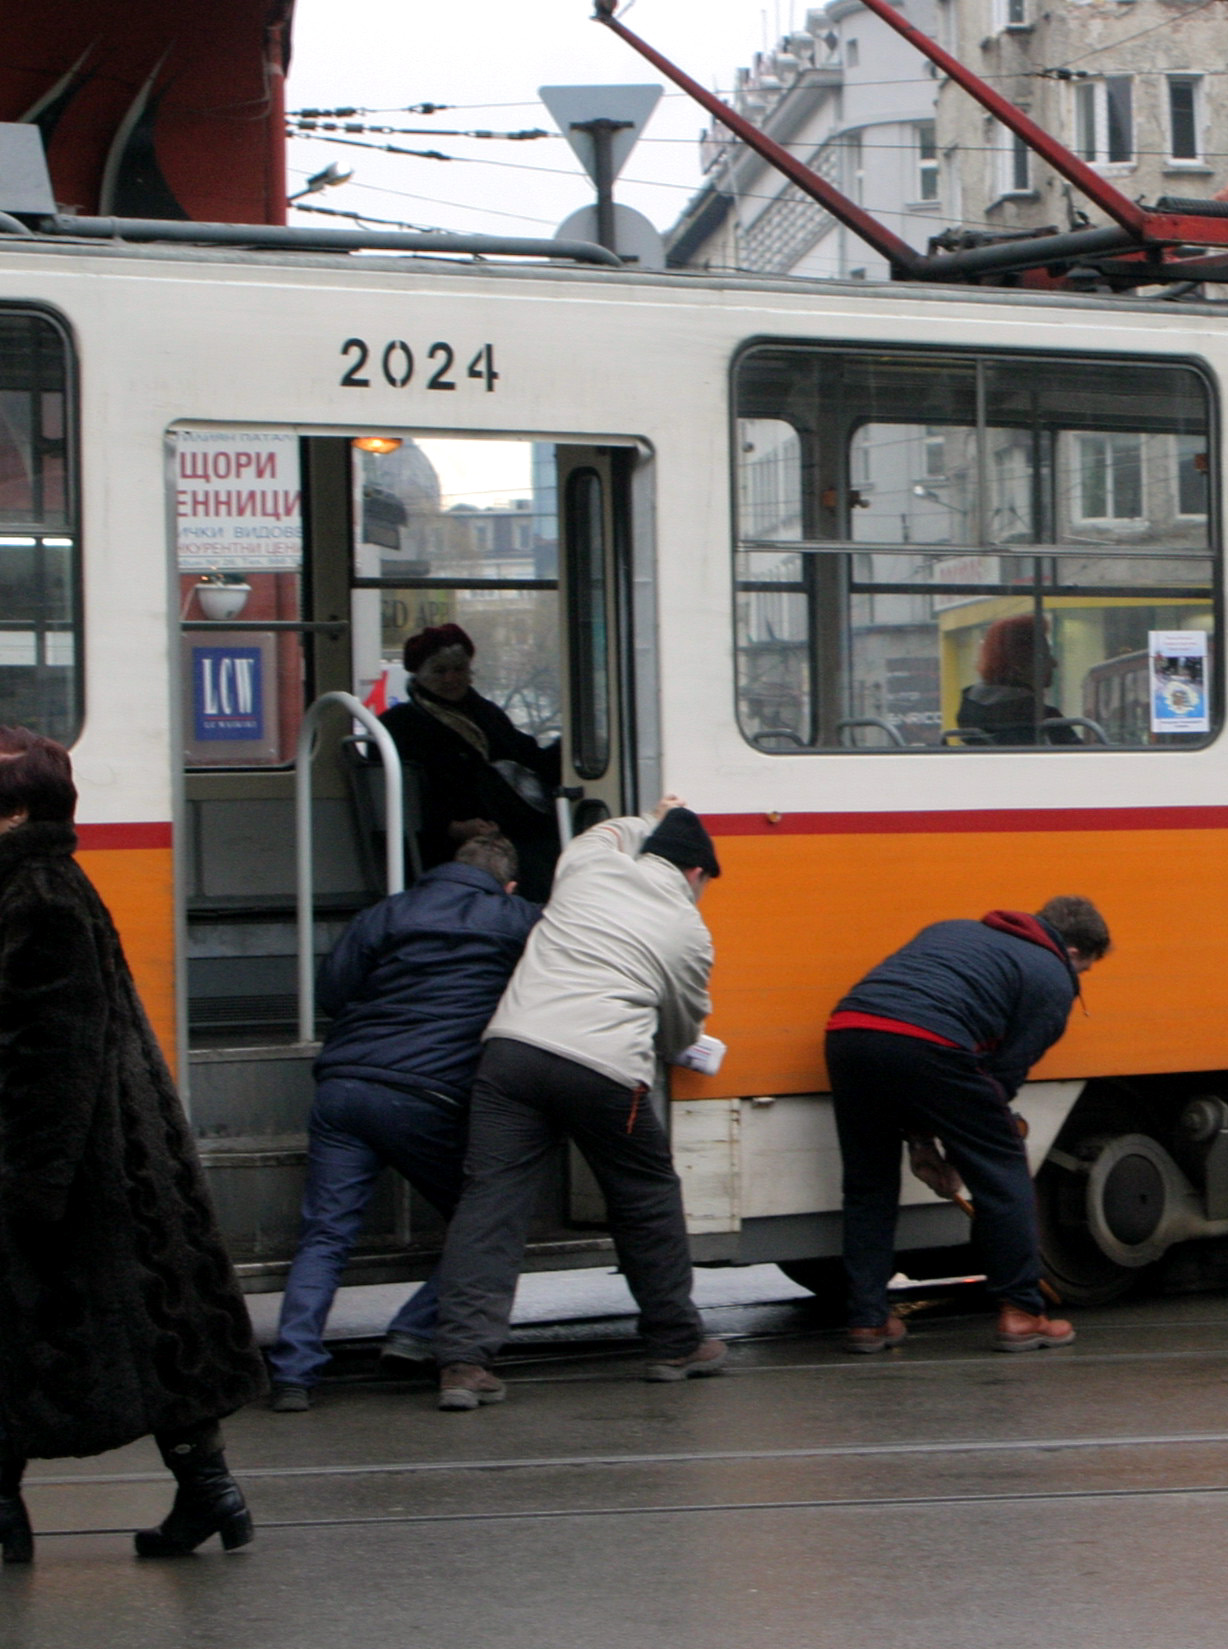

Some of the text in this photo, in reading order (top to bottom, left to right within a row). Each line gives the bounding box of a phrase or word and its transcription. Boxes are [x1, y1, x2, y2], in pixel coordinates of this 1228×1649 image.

[340, 337, 499, 392] 2024
[180, 451, 277, 483] ЩОРИ
[202, 658, 255, 714] LCW
